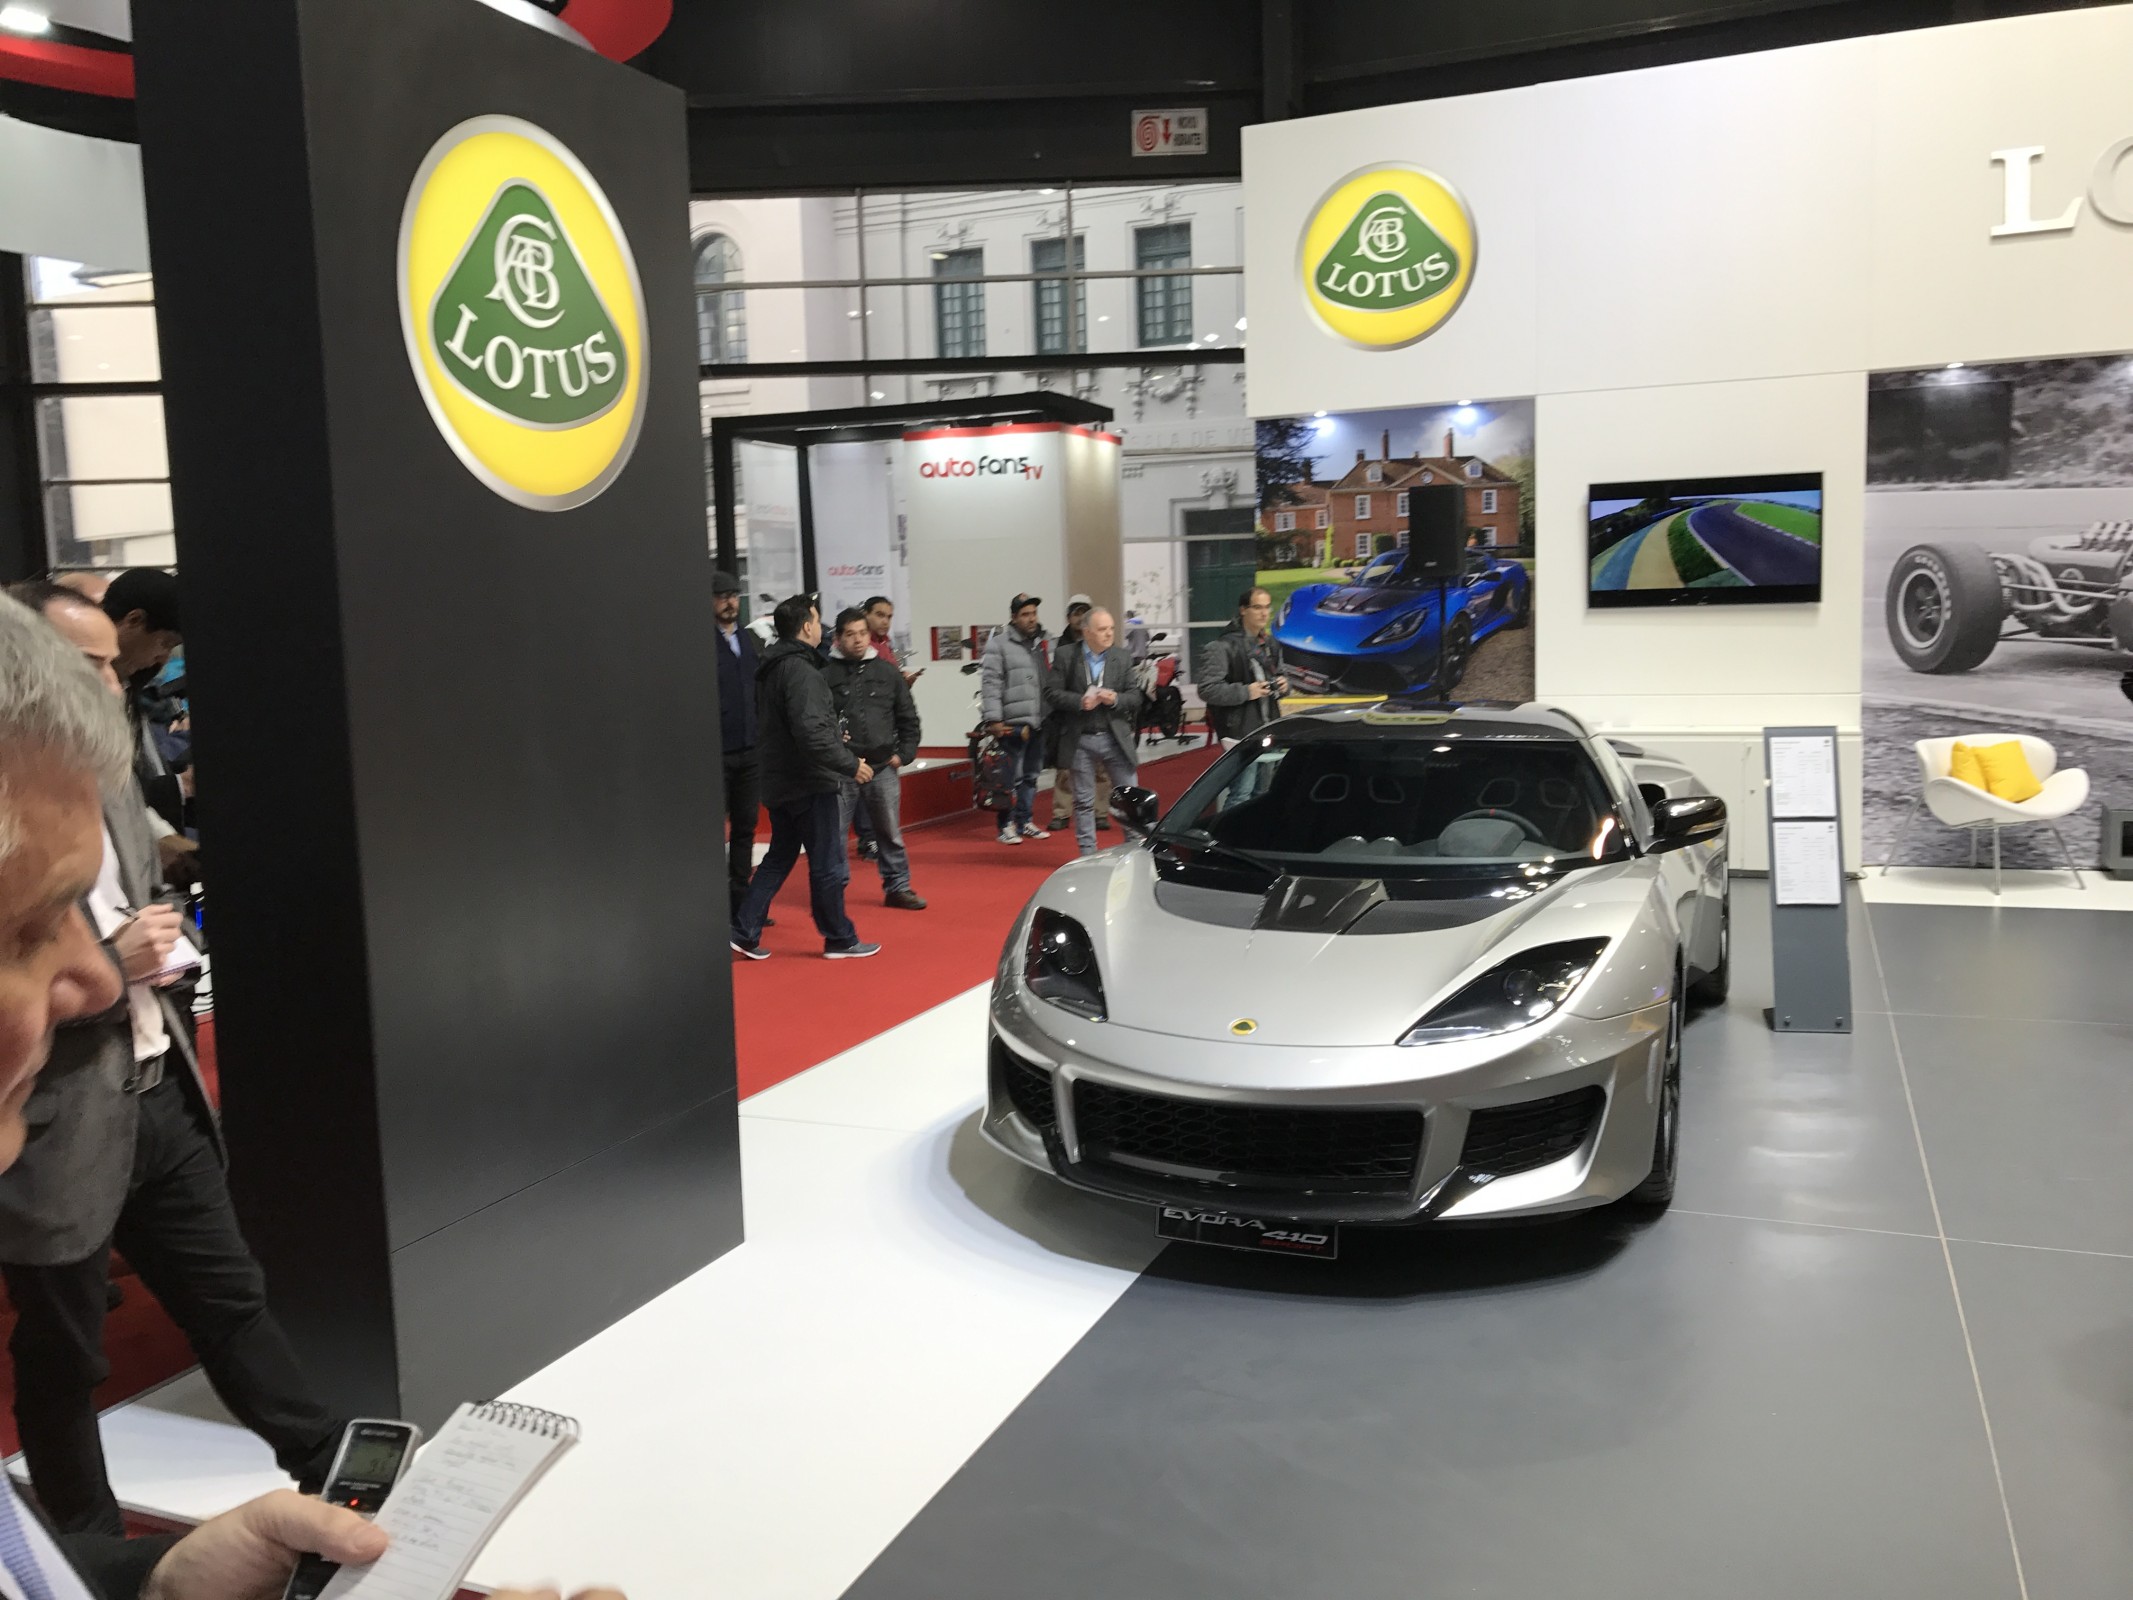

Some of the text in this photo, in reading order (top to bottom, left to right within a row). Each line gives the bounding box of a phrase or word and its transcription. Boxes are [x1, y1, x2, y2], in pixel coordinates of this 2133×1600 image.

[1322, 252, 1450, 298] LOTUS
[444, 303, 617, 399] LOTUS
[1163, 1207, 1329, 1246] EVORA 410
